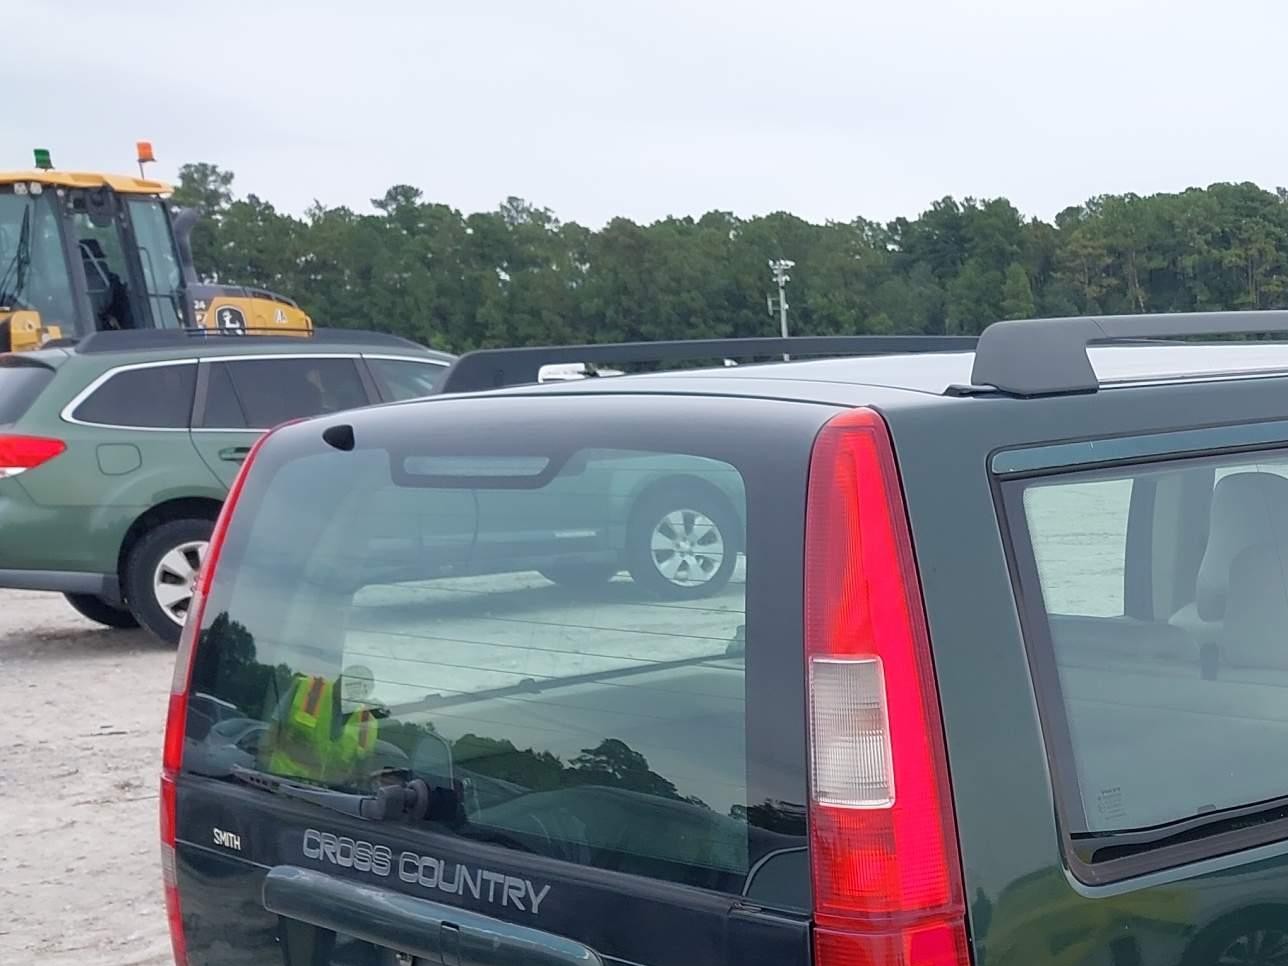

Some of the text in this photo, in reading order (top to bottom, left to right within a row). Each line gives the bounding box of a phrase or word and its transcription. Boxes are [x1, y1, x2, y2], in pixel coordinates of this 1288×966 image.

[213, 827, 241, 851] SMITH
[302, 828, 551, 914] CROSS COUNTRY
